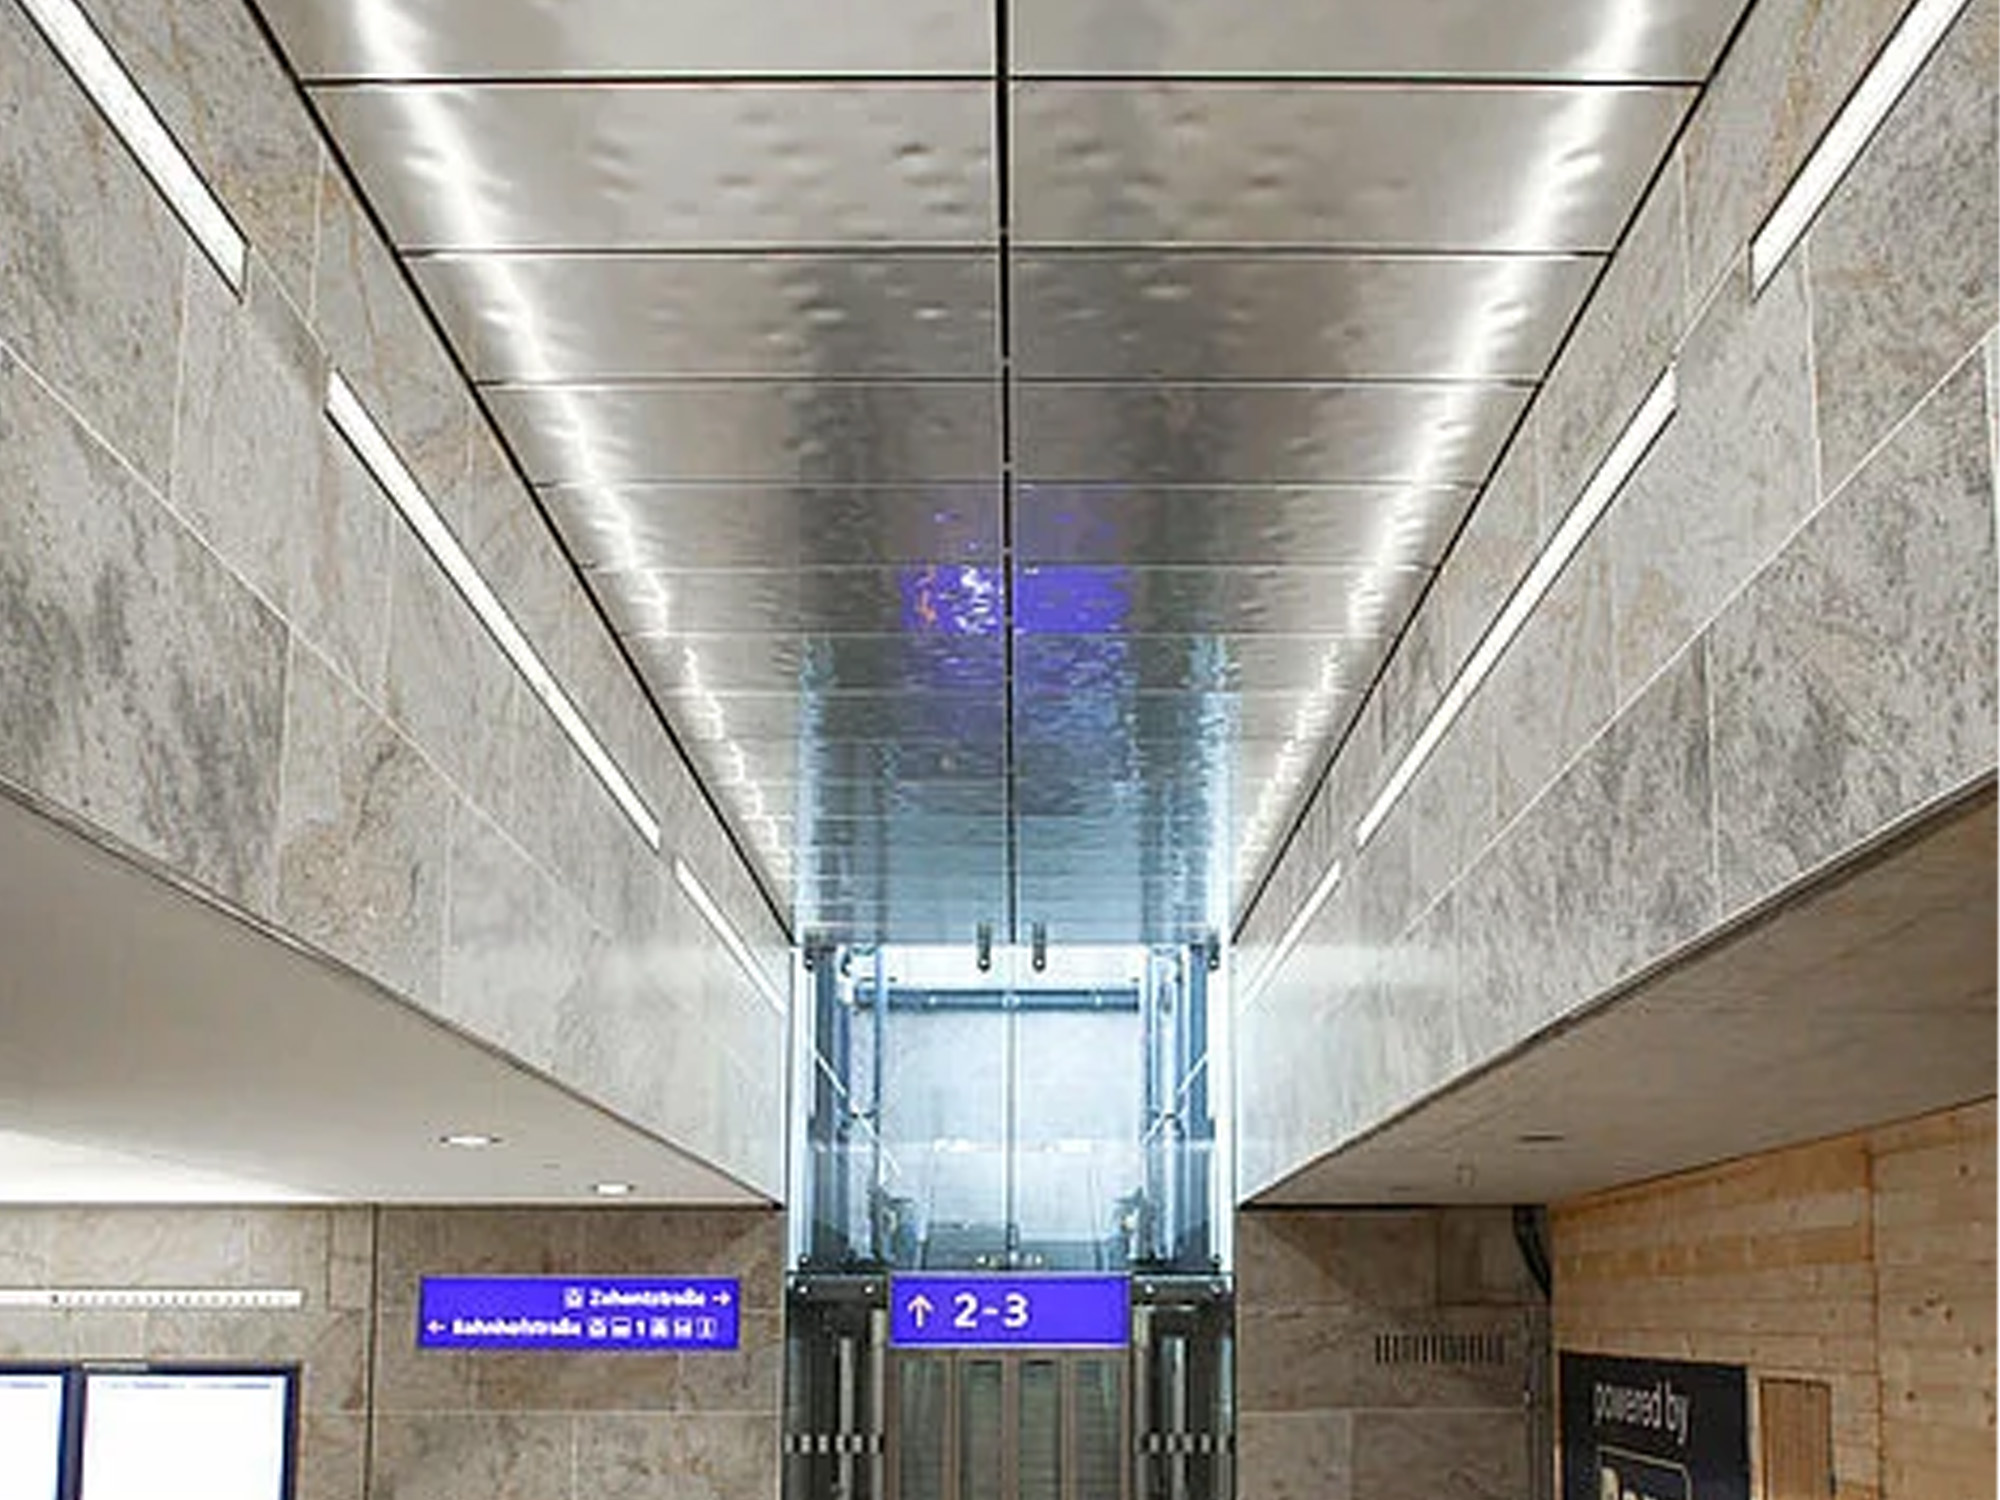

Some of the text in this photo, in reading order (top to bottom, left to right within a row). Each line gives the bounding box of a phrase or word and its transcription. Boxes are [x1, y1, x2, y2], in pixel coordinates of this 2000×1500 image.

[452, 1316, 582, 1336] Bahnhofstraße
[953, 1292, 1029, 1329] 2-3
[1593, 1379, 1689, 1445] powered by
